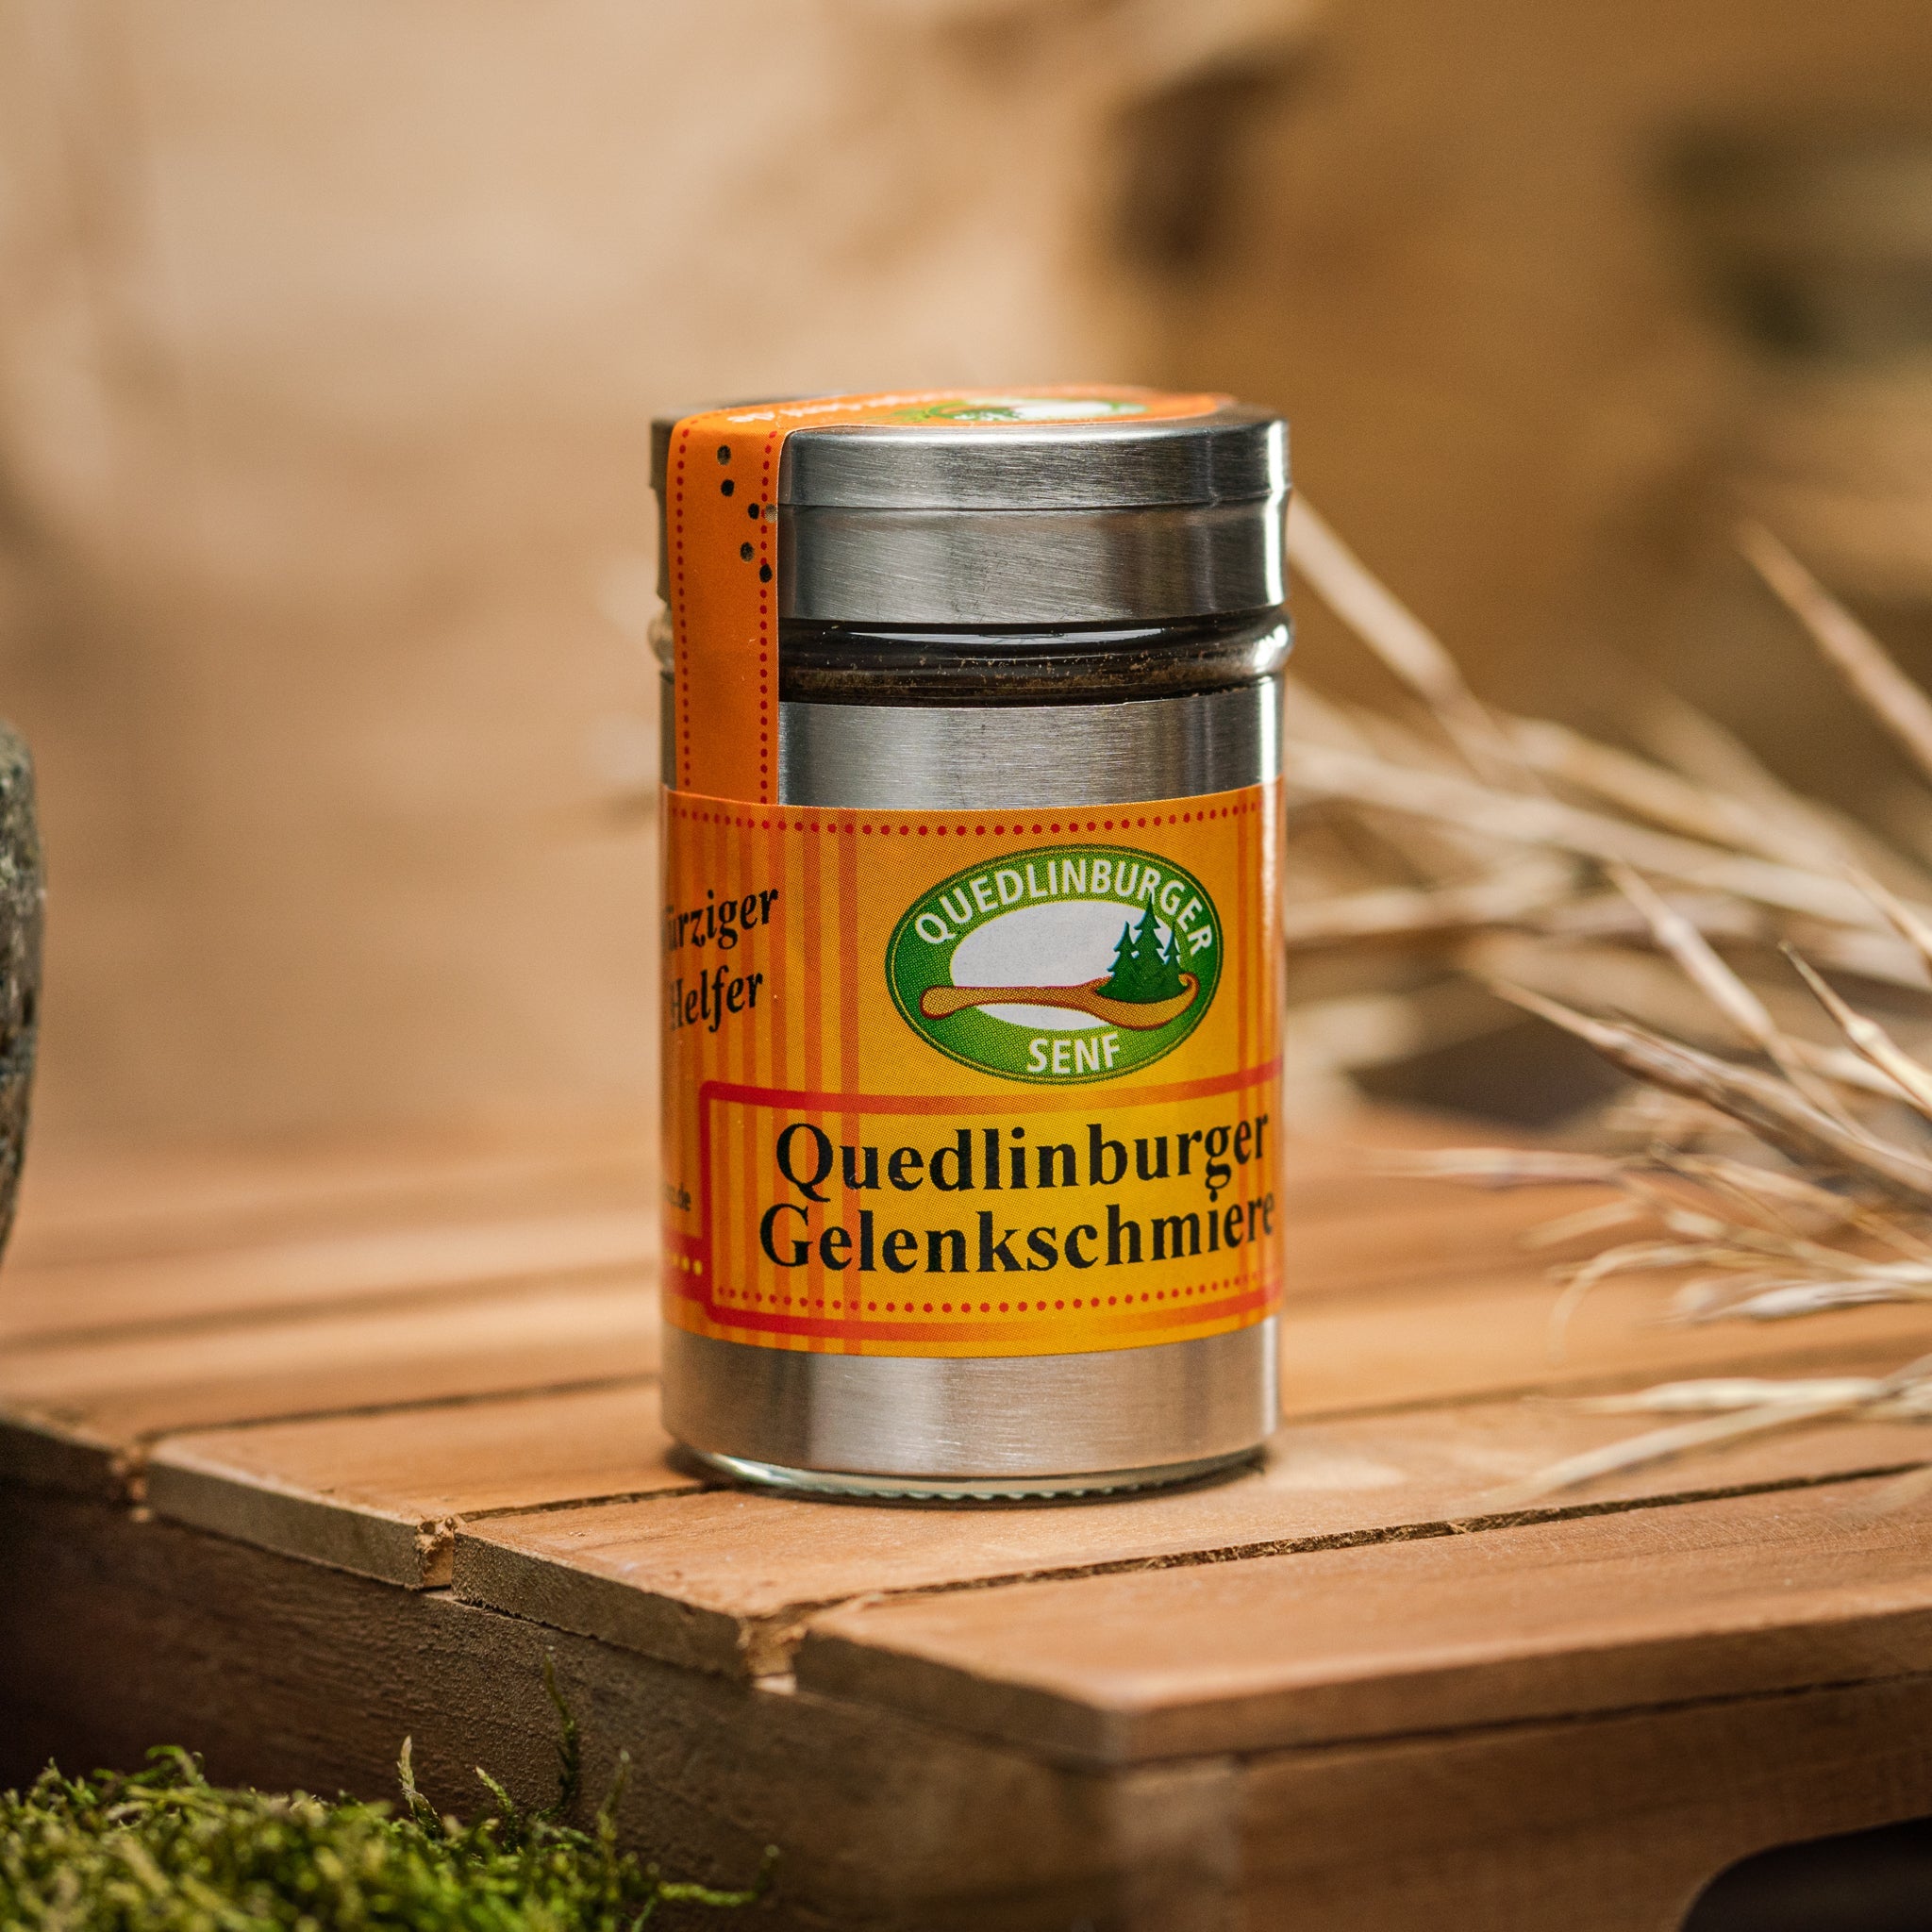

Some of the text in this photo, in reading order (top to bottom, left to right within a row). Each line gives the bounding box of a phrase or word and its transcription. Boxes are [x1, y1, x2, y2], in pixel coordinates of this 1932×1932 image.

[915, 858, 1213, 957] QUEDLINBURGER
[670, 964, 763, 1033] Helfer
[1026, 1032, 1122, 1074] SENF
[775, 1113, 1269, 1203] Quedlinburger
[759, 1188, 1274, 1274] Gelenkschmiere
